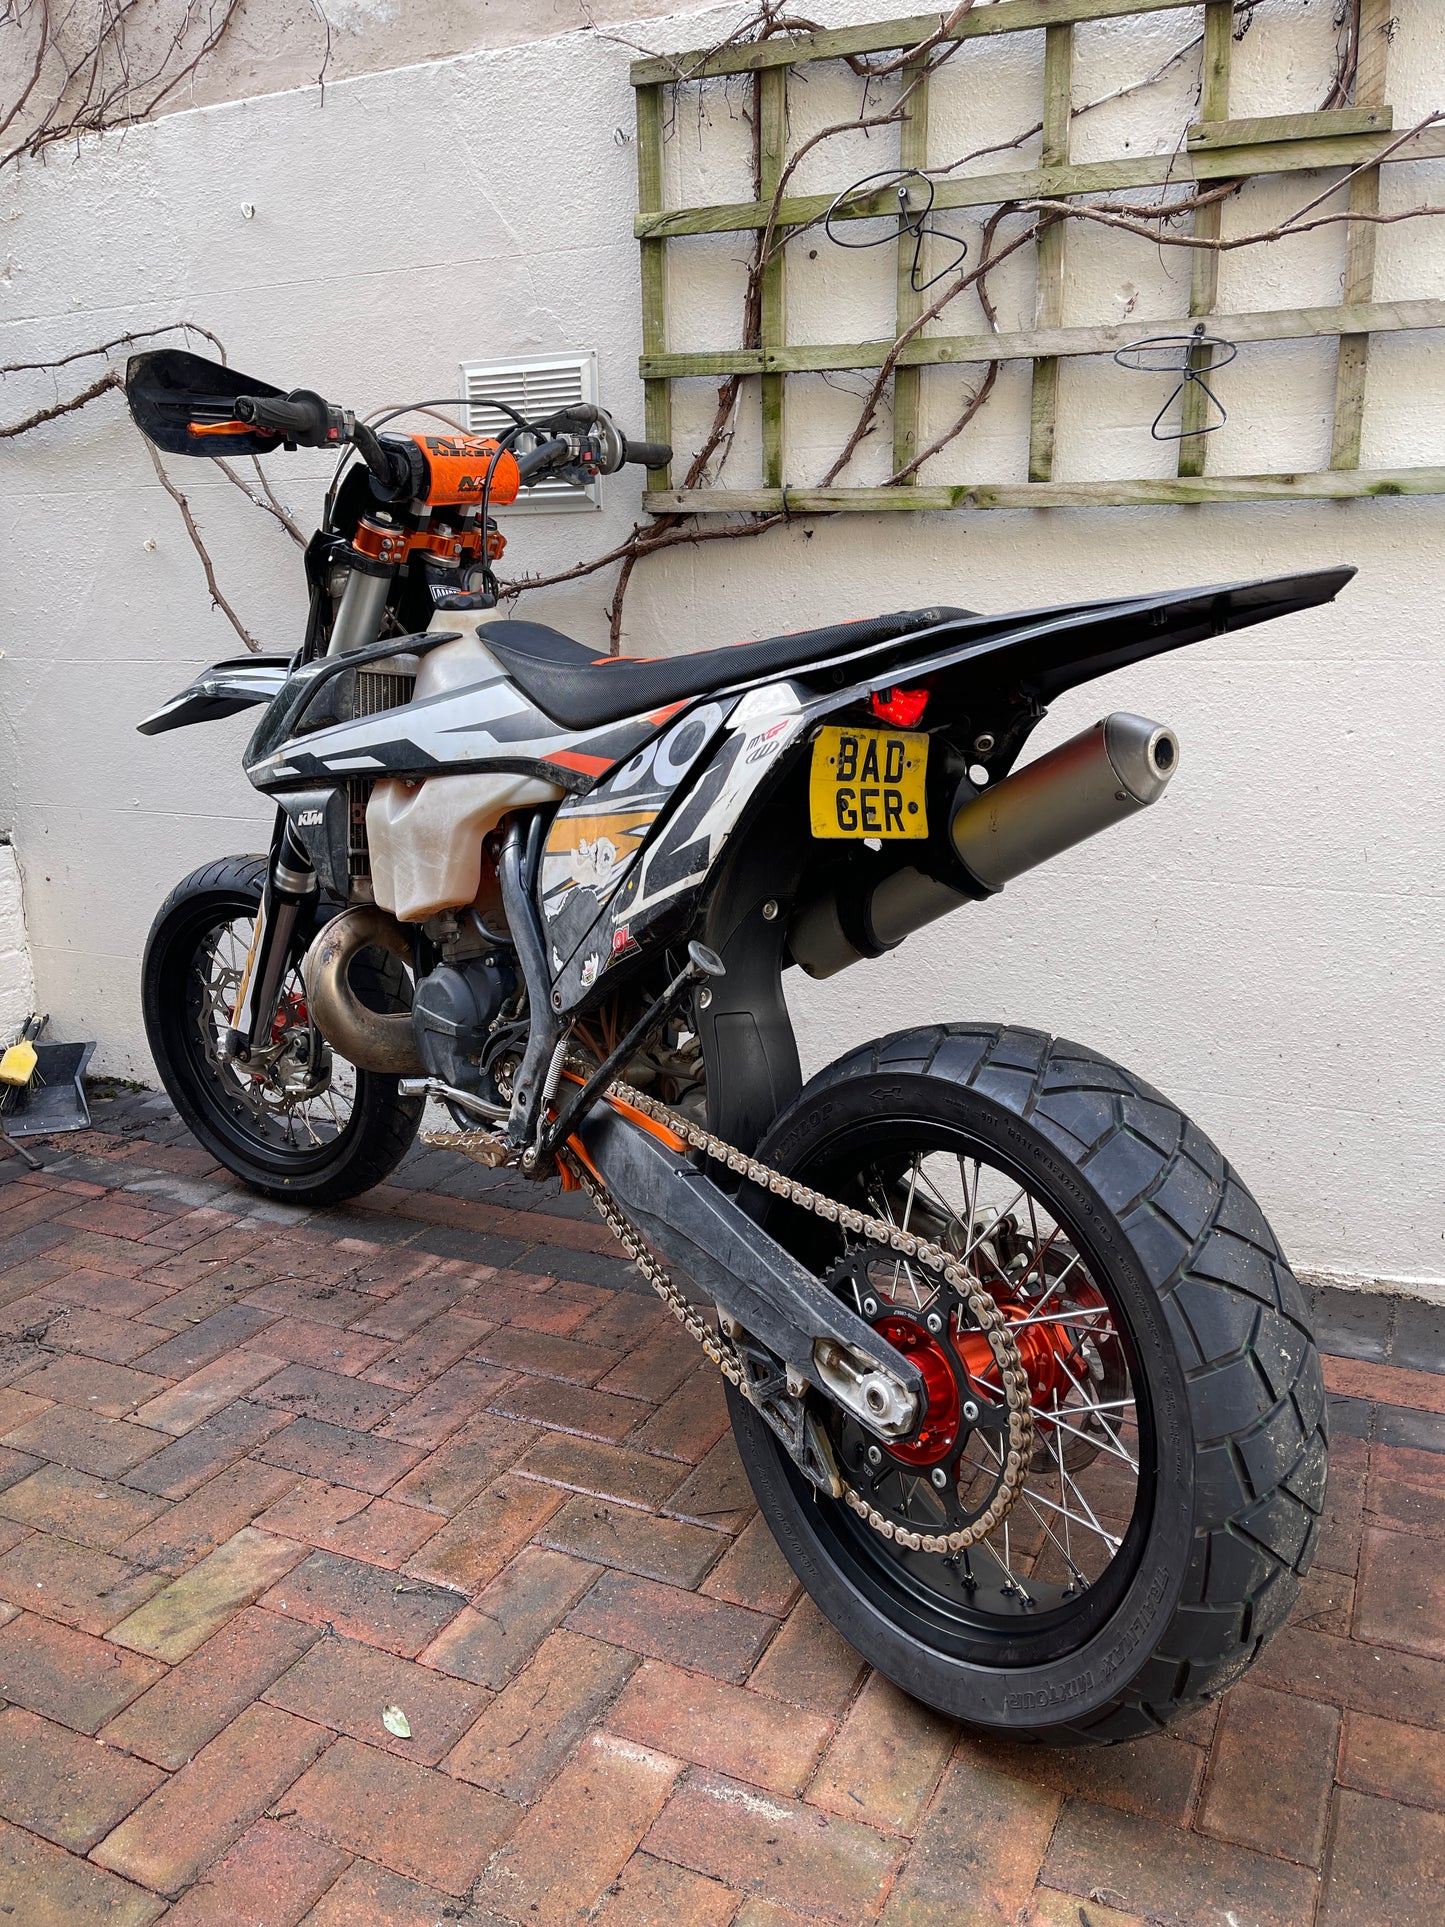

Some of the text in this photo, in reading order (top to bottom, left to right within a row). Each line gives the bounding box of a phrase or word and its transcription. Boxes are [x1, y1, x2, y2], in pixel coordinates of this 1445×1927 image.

[836, 736, 905, 783] BAD
[298, 810, 324, 827] KTM
[836, 788, 906, 832] GER
[1008, 1566, 1170, 1710] TRAILMAX MIXTOUR
